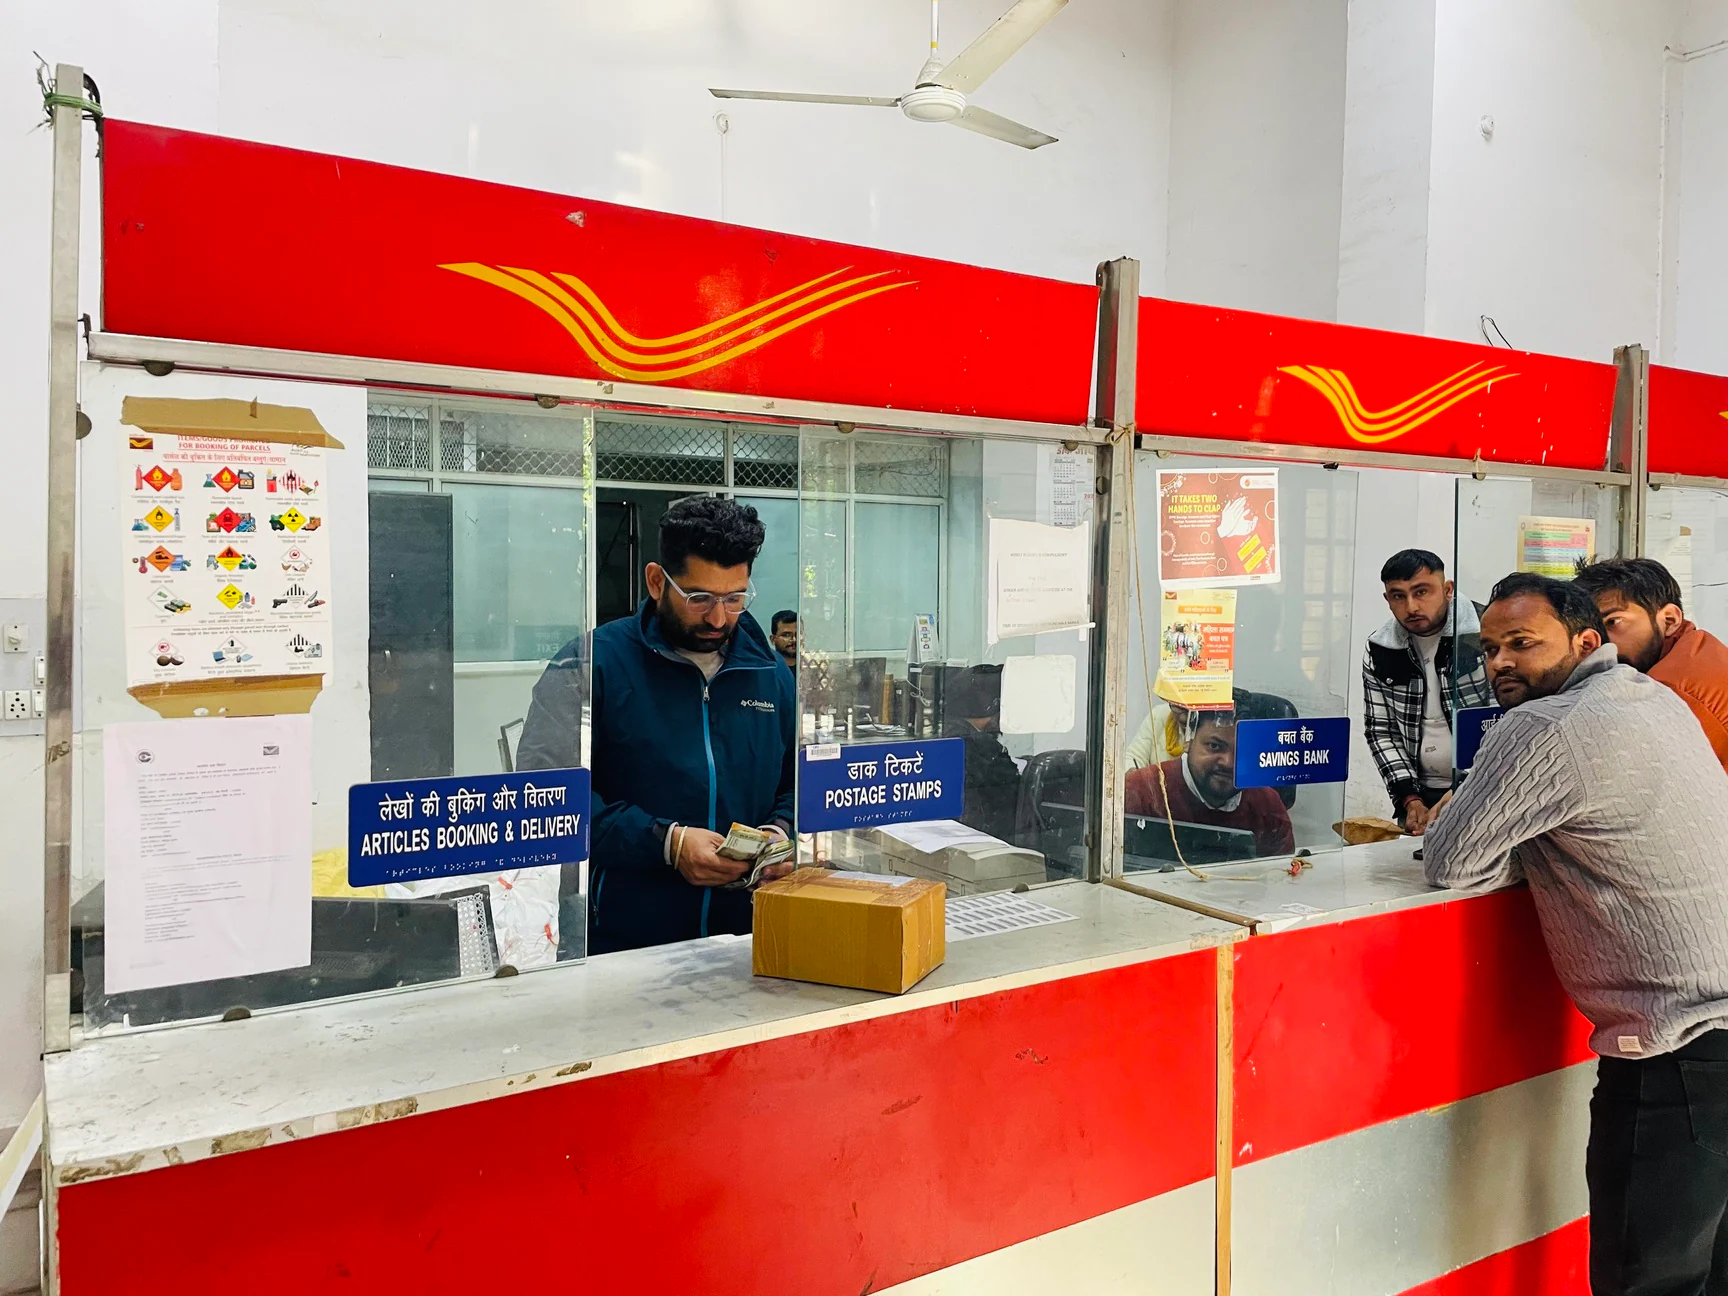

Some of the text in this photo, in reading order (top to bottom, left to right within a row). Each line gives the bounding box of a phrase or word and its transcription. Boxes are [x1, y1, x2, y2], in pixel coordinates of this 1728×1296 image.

[195, 442, 228, 450] BOOKING
[242, 443, 271, 452] PARCELS
[1171, 494, 1217, 503] IT TAKES TWO
[1168, 504, 1192, 514] HANDS
[1193, 504, 1203, 513] TO
[747, 699, 775, 708] Columbia
[1277, 726, 1314, 745] बचत बैंक
[847, 750, 924, 780] डाक टिकटें
[1259, 749, 1330, 768] SAVINGS BANK
[379, 782, 567, 822] लेखों की बुकिंग और वितरण
[825, 780, 942, 809] POSTAGE STAMPS
[361, 813, 581, 857] ARTICLES BOOKING & DELIVERY
